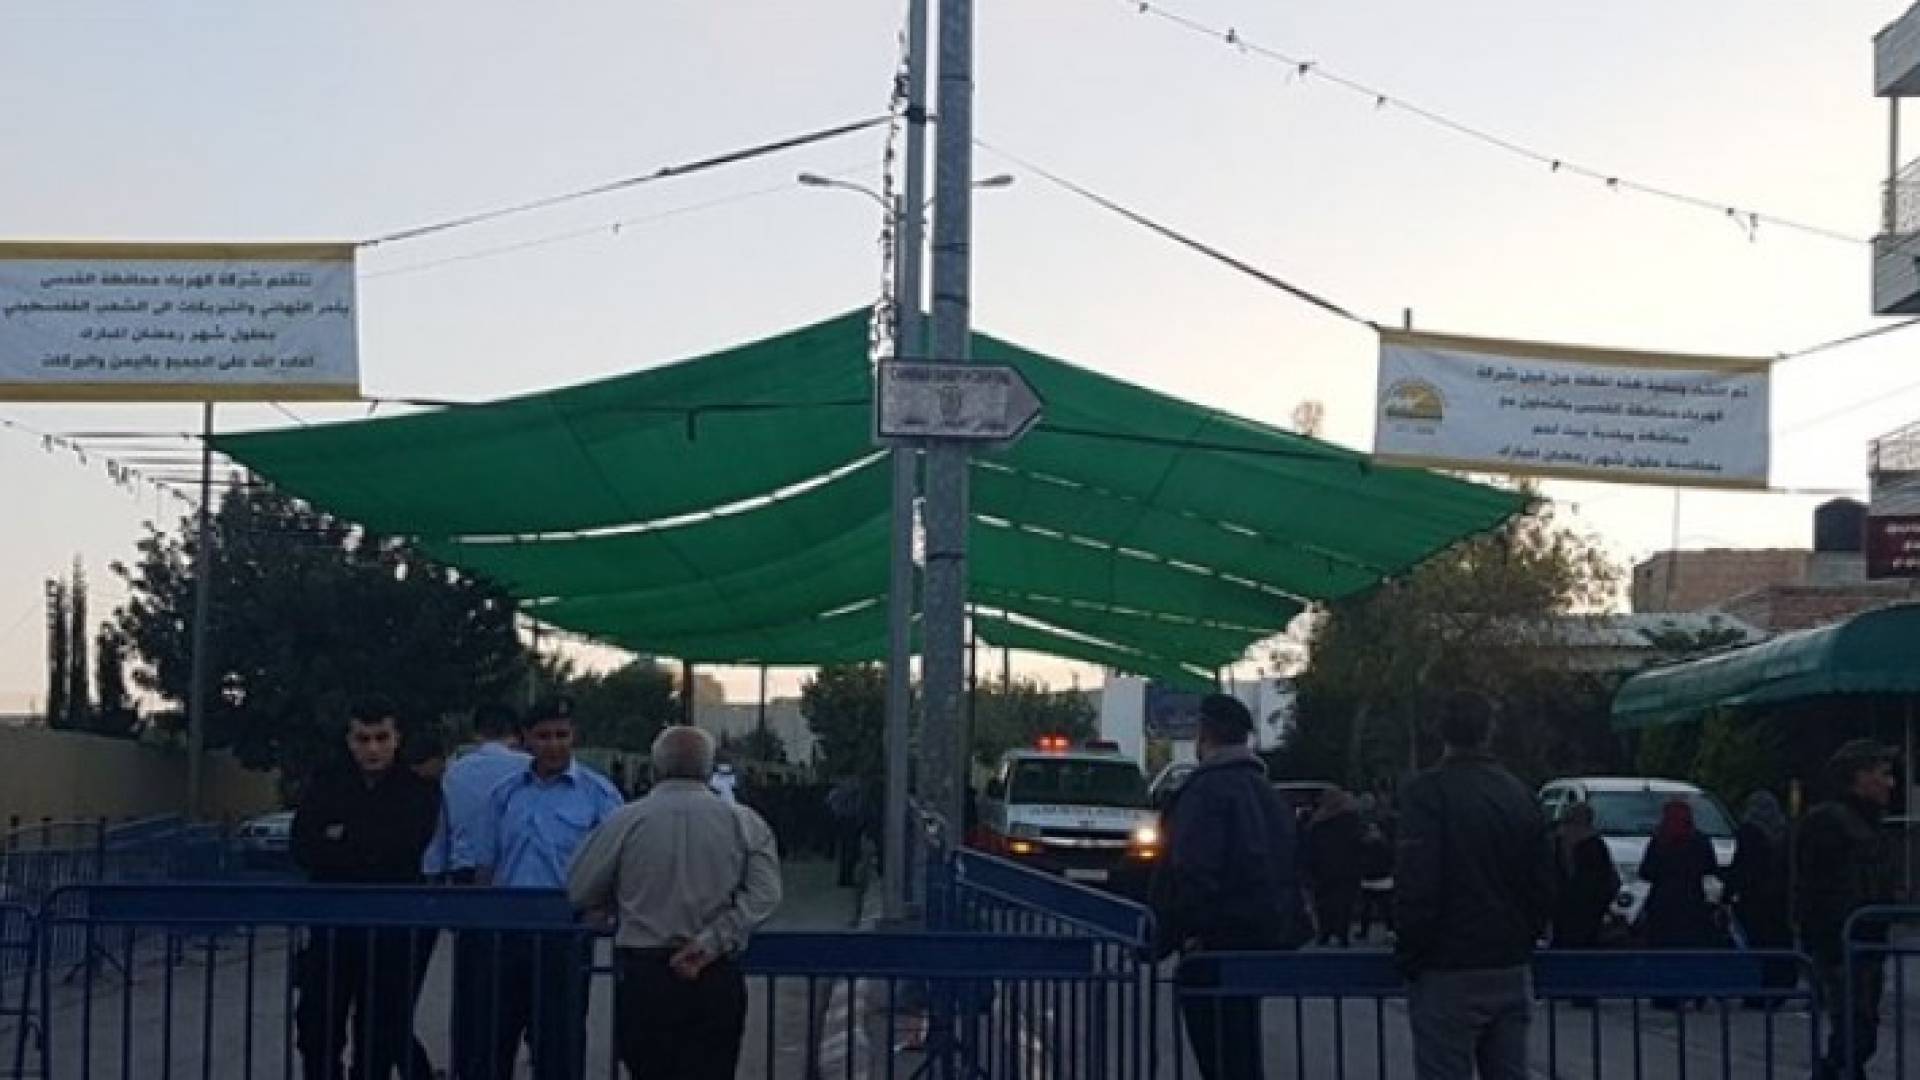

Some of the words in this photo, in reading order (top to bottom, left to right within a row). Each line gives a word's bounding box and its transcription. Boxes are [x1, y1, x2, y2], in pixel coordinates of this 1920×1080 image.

[41, 272, 96, 288] القدس
[3, 300, 90, 318] الفلسطيني
[78, 325, 129, 342] المبارك
[131, 325, 185, 344] رمضان
[189, 322, 227, 344] شهر
